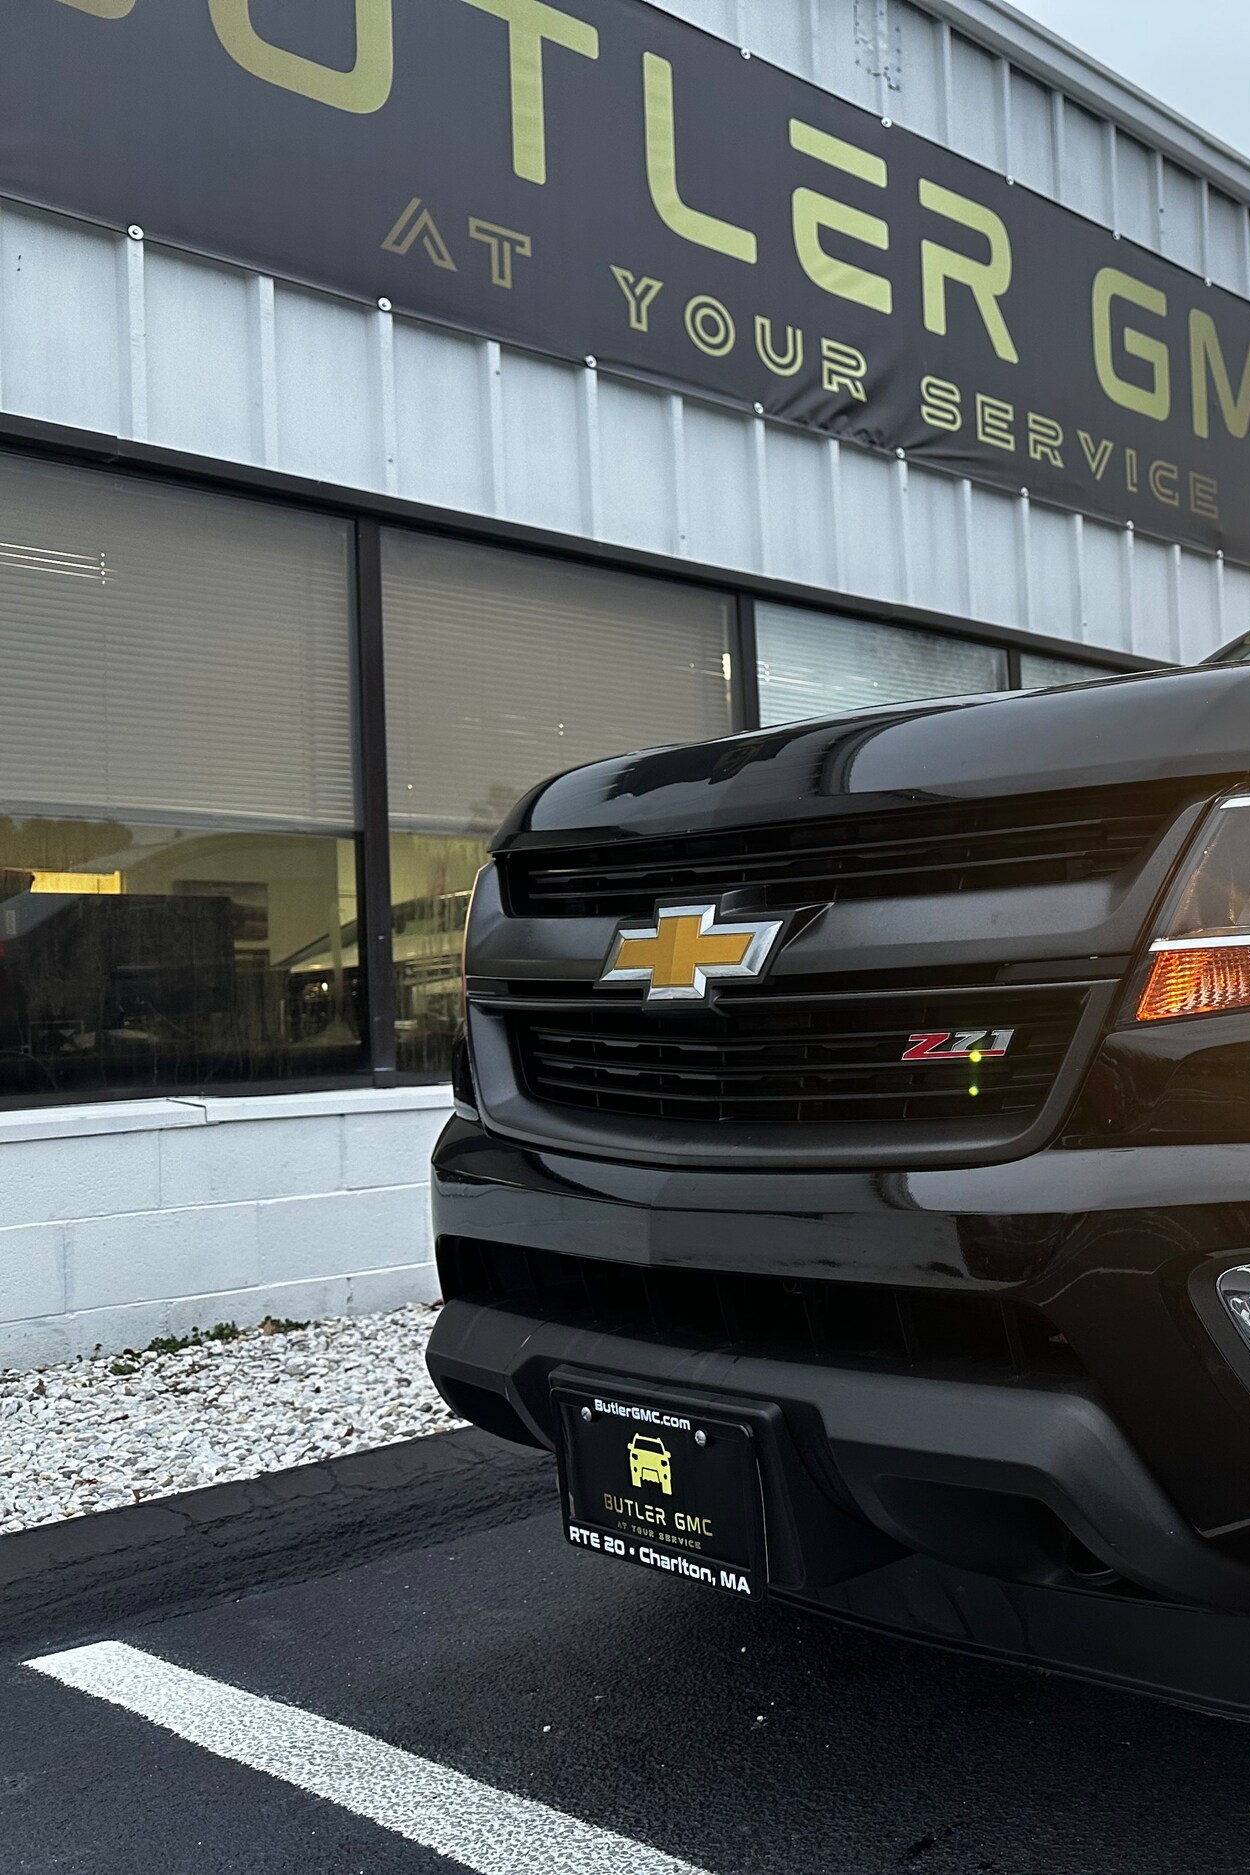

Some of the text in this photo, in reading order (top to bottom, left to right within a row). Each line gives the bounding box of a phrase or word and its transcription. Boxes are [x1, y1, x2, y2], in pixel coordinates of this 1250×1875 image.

[56, 0, 1018, 363] UTLER
[380, 197, 1220, 520] AT YOUR SERVICE
[901, 1029, 1014, 1060] Z71
[594, 1399, 691, 1430] ButlerGMC.com
[604, 1493, 713, 1537] BUTLER GMC
[617, 1521, 702, 1550] AT YOUR SERVICE
[569, 1526, 751, 1594] RTE 20 Charlton, MA
